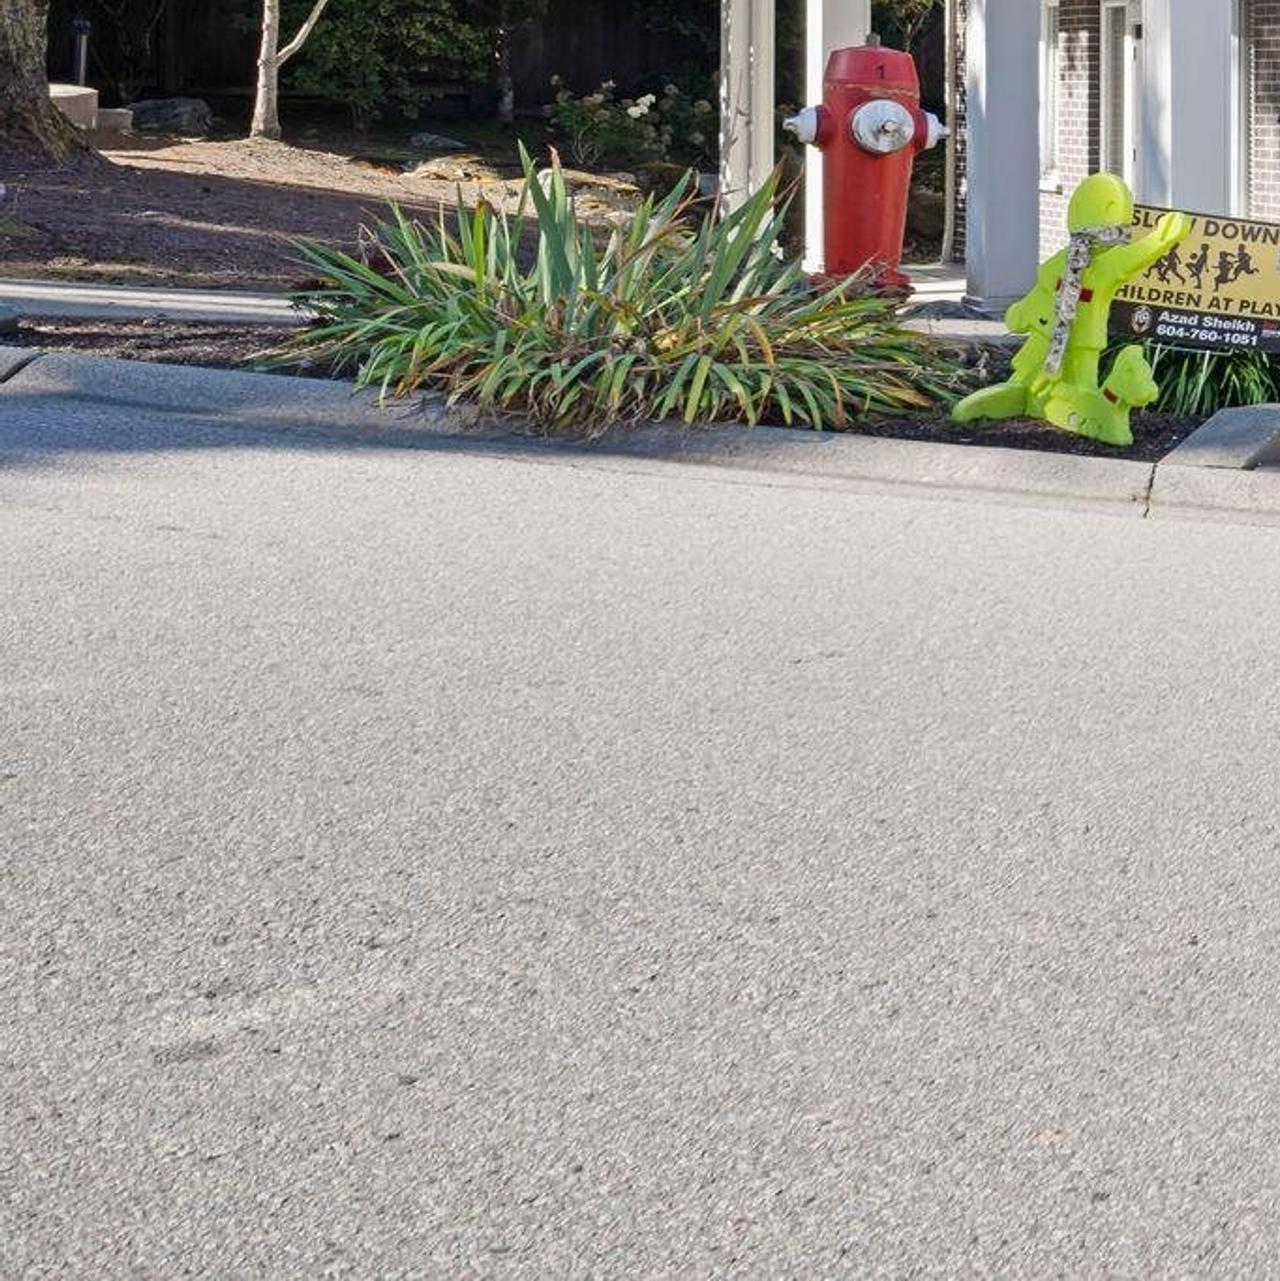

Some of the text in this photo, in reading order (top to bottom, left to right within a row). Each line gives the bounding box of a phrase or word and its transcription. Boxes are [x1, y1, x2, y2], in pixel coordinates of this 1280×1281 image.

[1131, 208, 1197, 234] SL
[1114, 284, 1203, 308] HILDREN
[1207, 297, 1234, 312] AT
[1158, 310, 1199, 326] Azad
[1202, 315, 1256, 332] Sheikh
[1156, 323, 1258, 346] 604-760-1051
